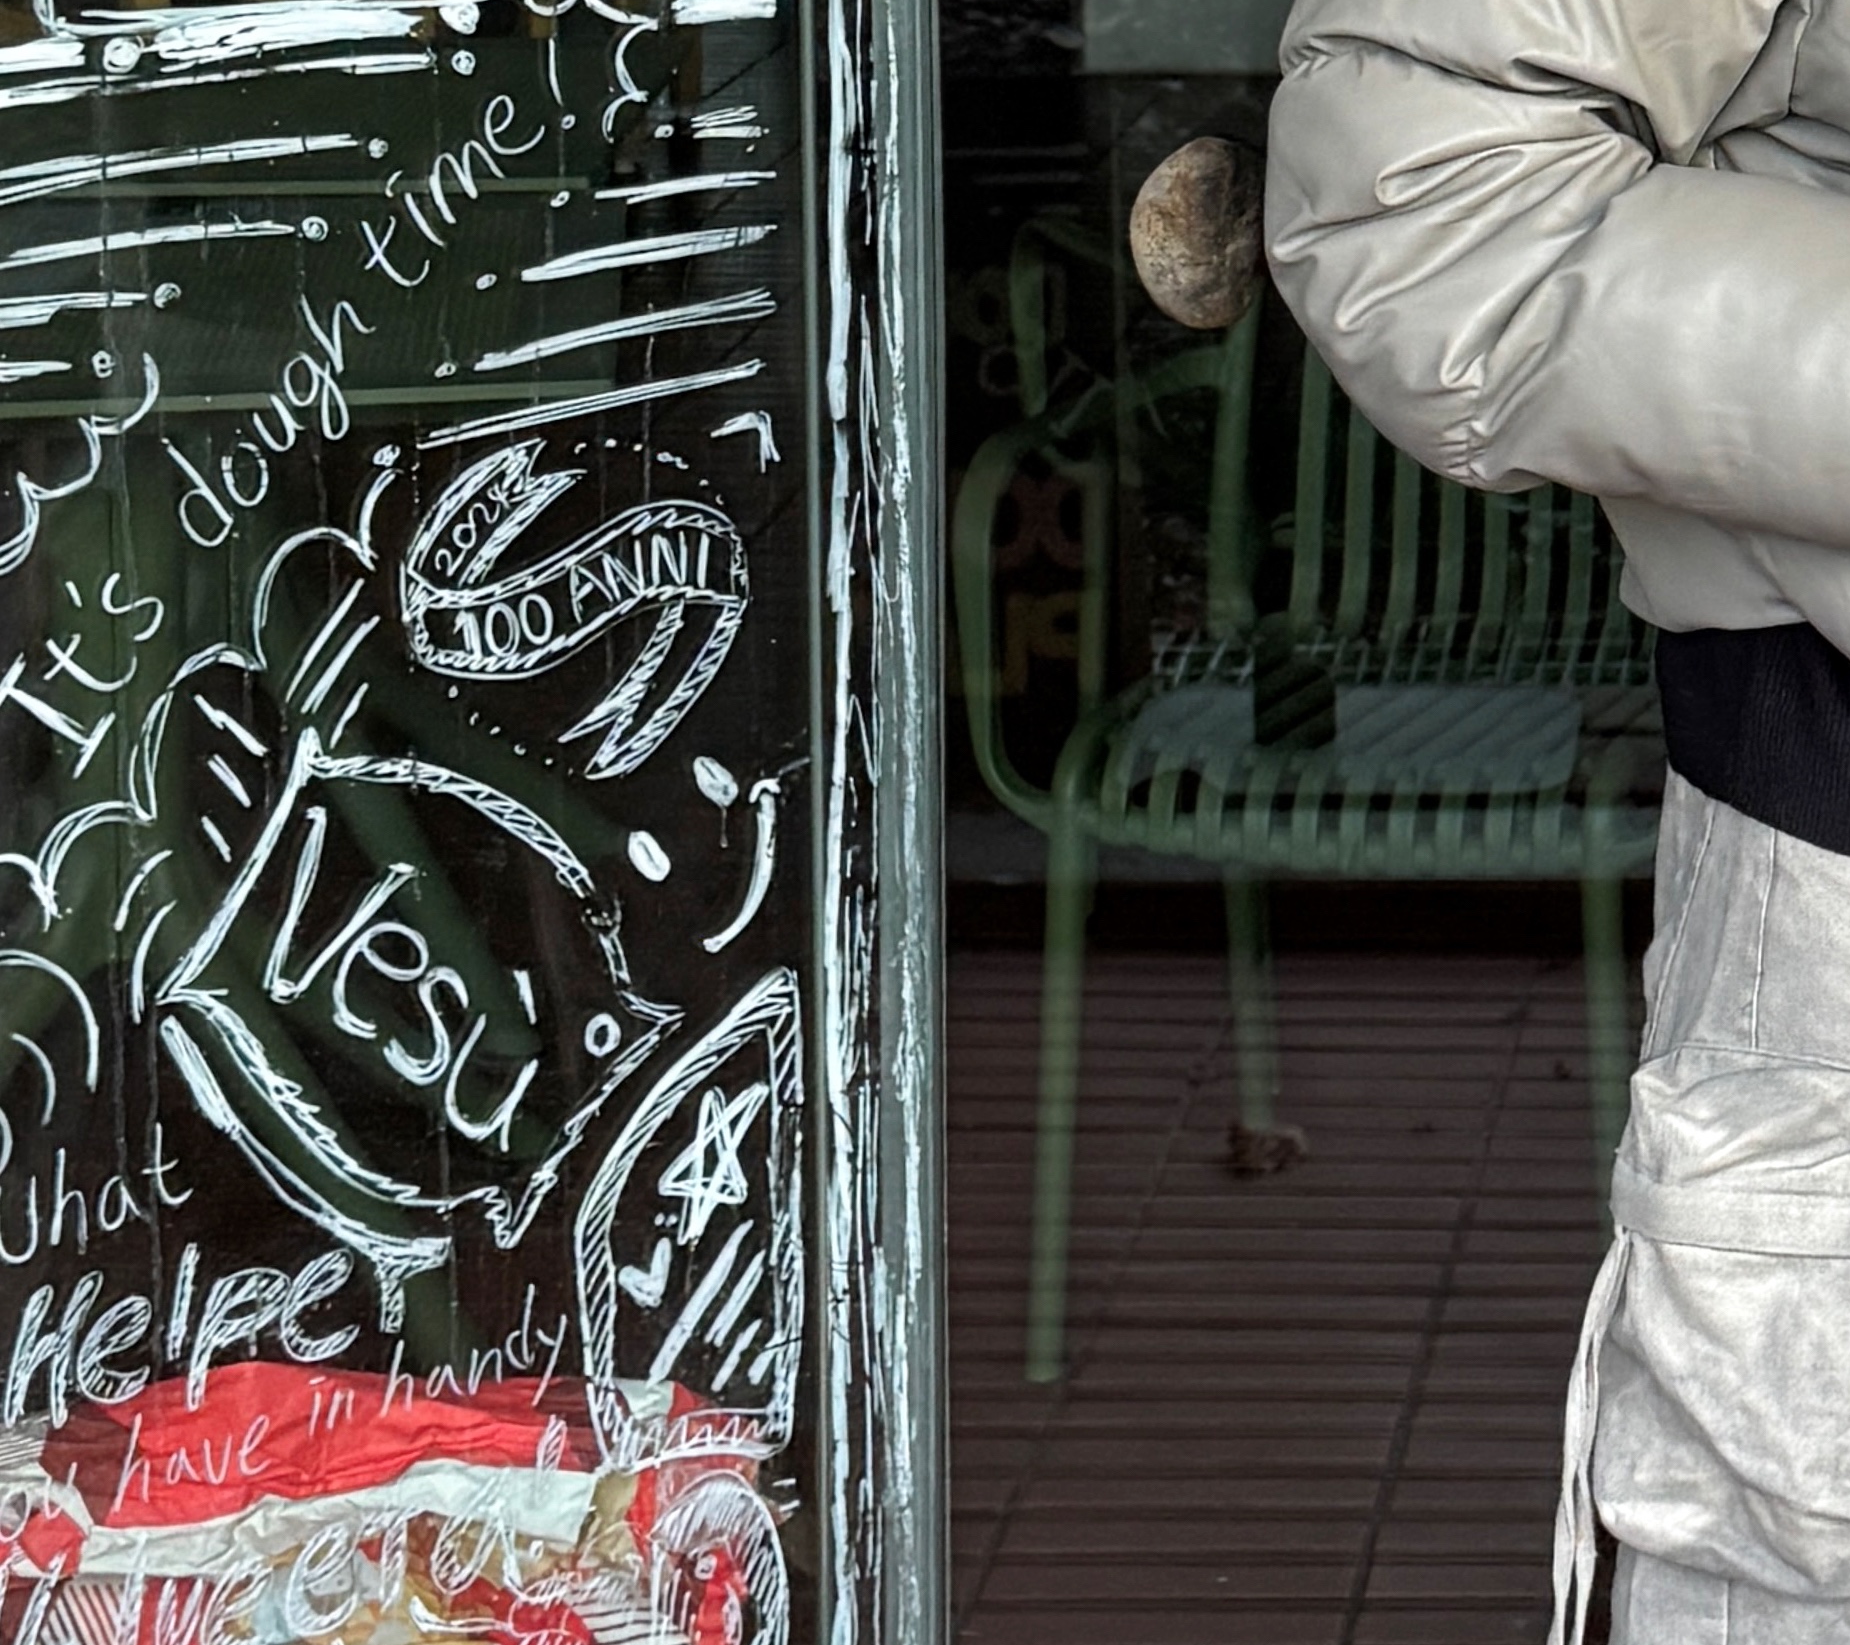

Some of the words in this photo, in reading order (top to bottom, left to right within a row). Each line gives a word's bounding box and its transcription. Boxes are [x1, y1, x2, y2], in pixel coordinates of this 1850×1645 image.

[178, 294, 376, 548] dough
[452, 592, 554, 657] 100
[569, 530, 711, 625] ANNI
[114, 1413, 271, 1513] have
[307, 1377, 354, 1436] in
[379, 1284, 567, 1418] handy
